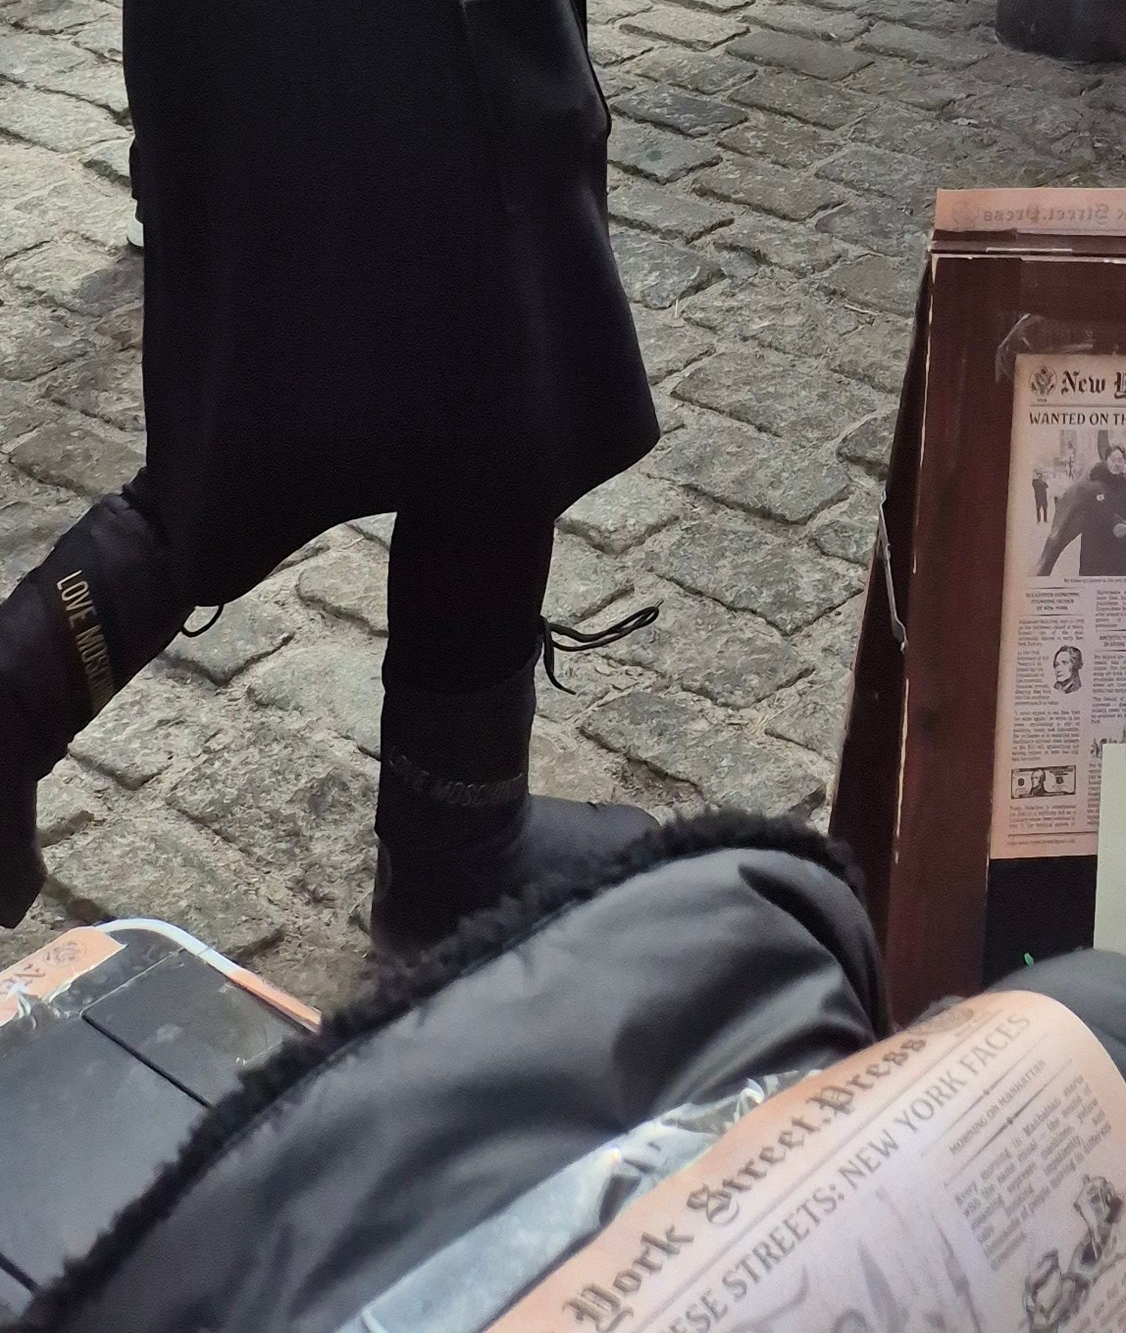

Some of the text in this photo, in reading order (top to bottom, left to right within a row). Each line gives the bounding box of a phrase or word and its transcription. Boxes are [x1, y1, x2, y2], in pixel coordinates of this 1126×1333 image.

[1061, 368, 1106, 395] New
[1029, 412, 1086, 427] WANTED
[1089, 412, 1109, 427] ON
[57, 570, 97, 629] LOVE
[950, 1117, 986, 1153] MORNING
[1000, 1061, 1044, 1105] MANHATTAN
[722, 1183, 846, 1303] STREETS:
[841, 1131, 902, 1193] NEW
[892, 1068, 970, 1138] YORK
[957, 1013, 1032, 1083] FACES
[562, 1223, 695, 1333] York
